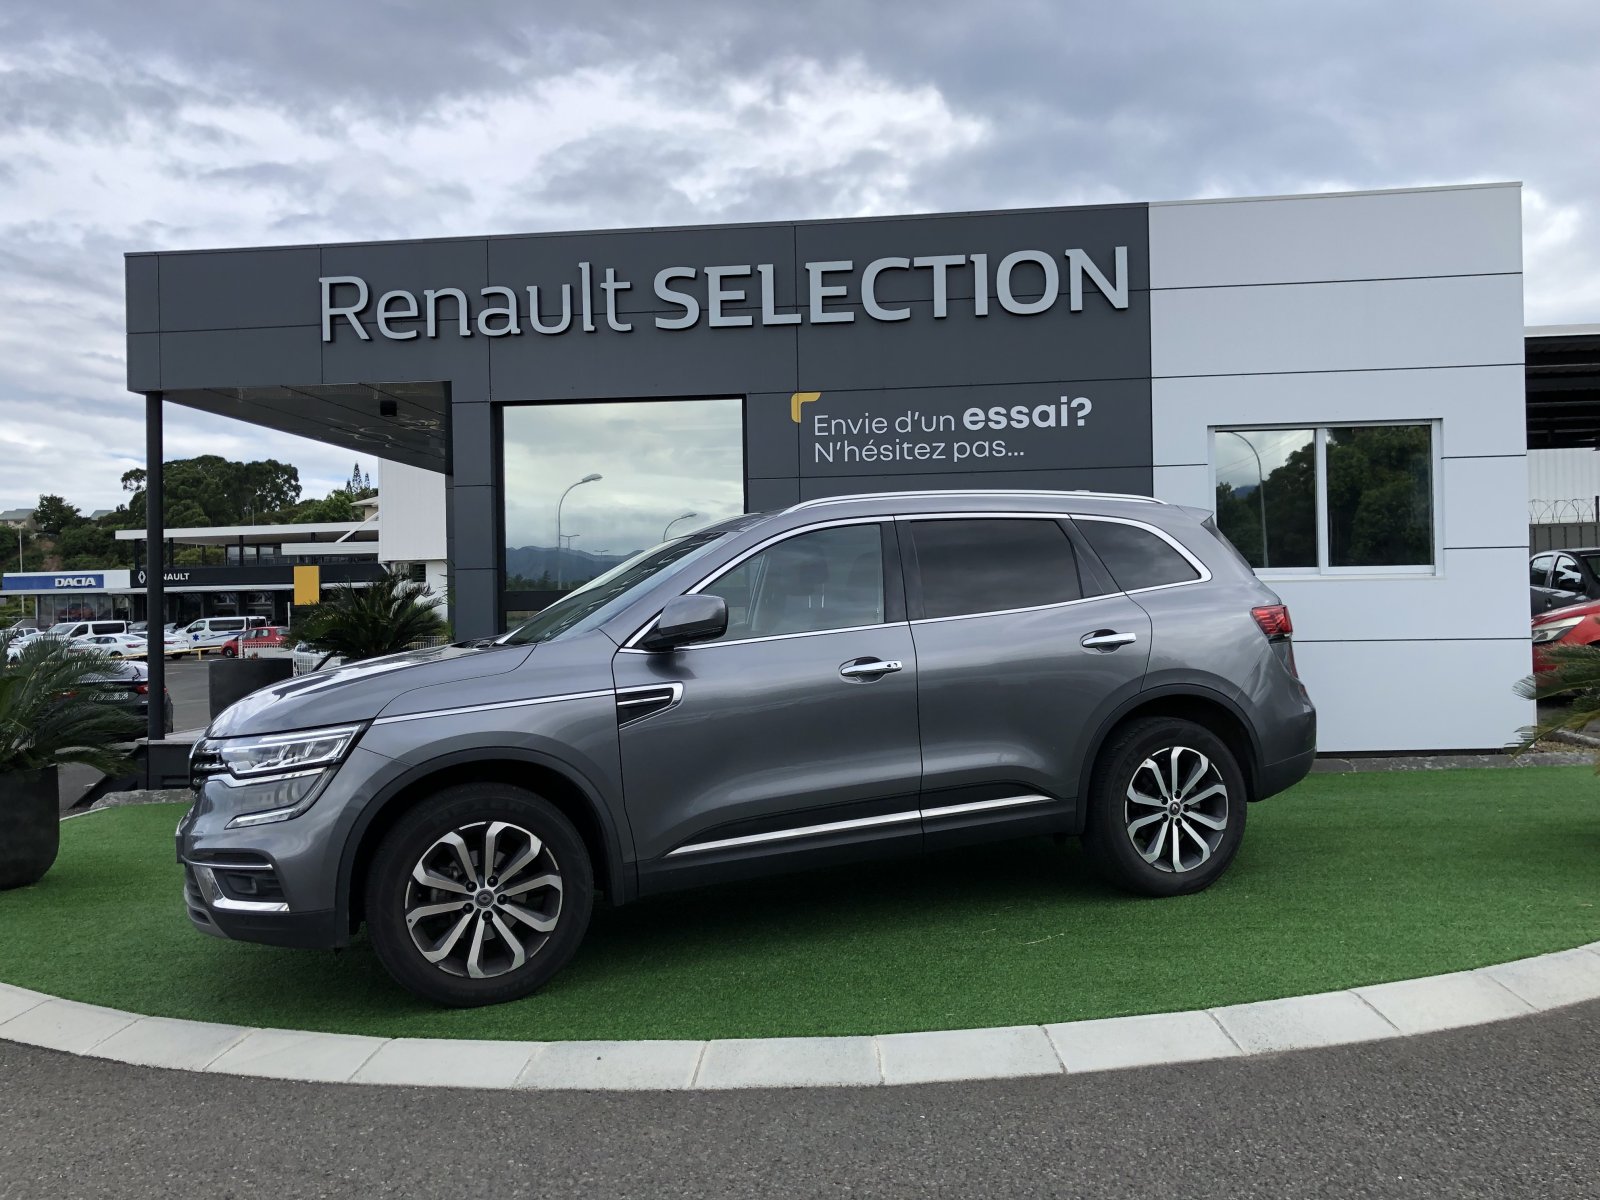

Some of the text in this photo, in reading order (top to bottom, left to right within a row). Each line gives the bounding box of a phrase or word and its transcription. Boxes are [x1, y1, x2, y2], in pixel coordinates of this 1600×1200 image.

[319, 246, 1129, 342] Renault SELECTION
[814, 396, 1093, 436] Envie d'un essai?
[814, 438, 1025, 463] N'hésitez pas...
[54, 577, 96, 587] DACIA
[163, 572, 190, 581] AULT
